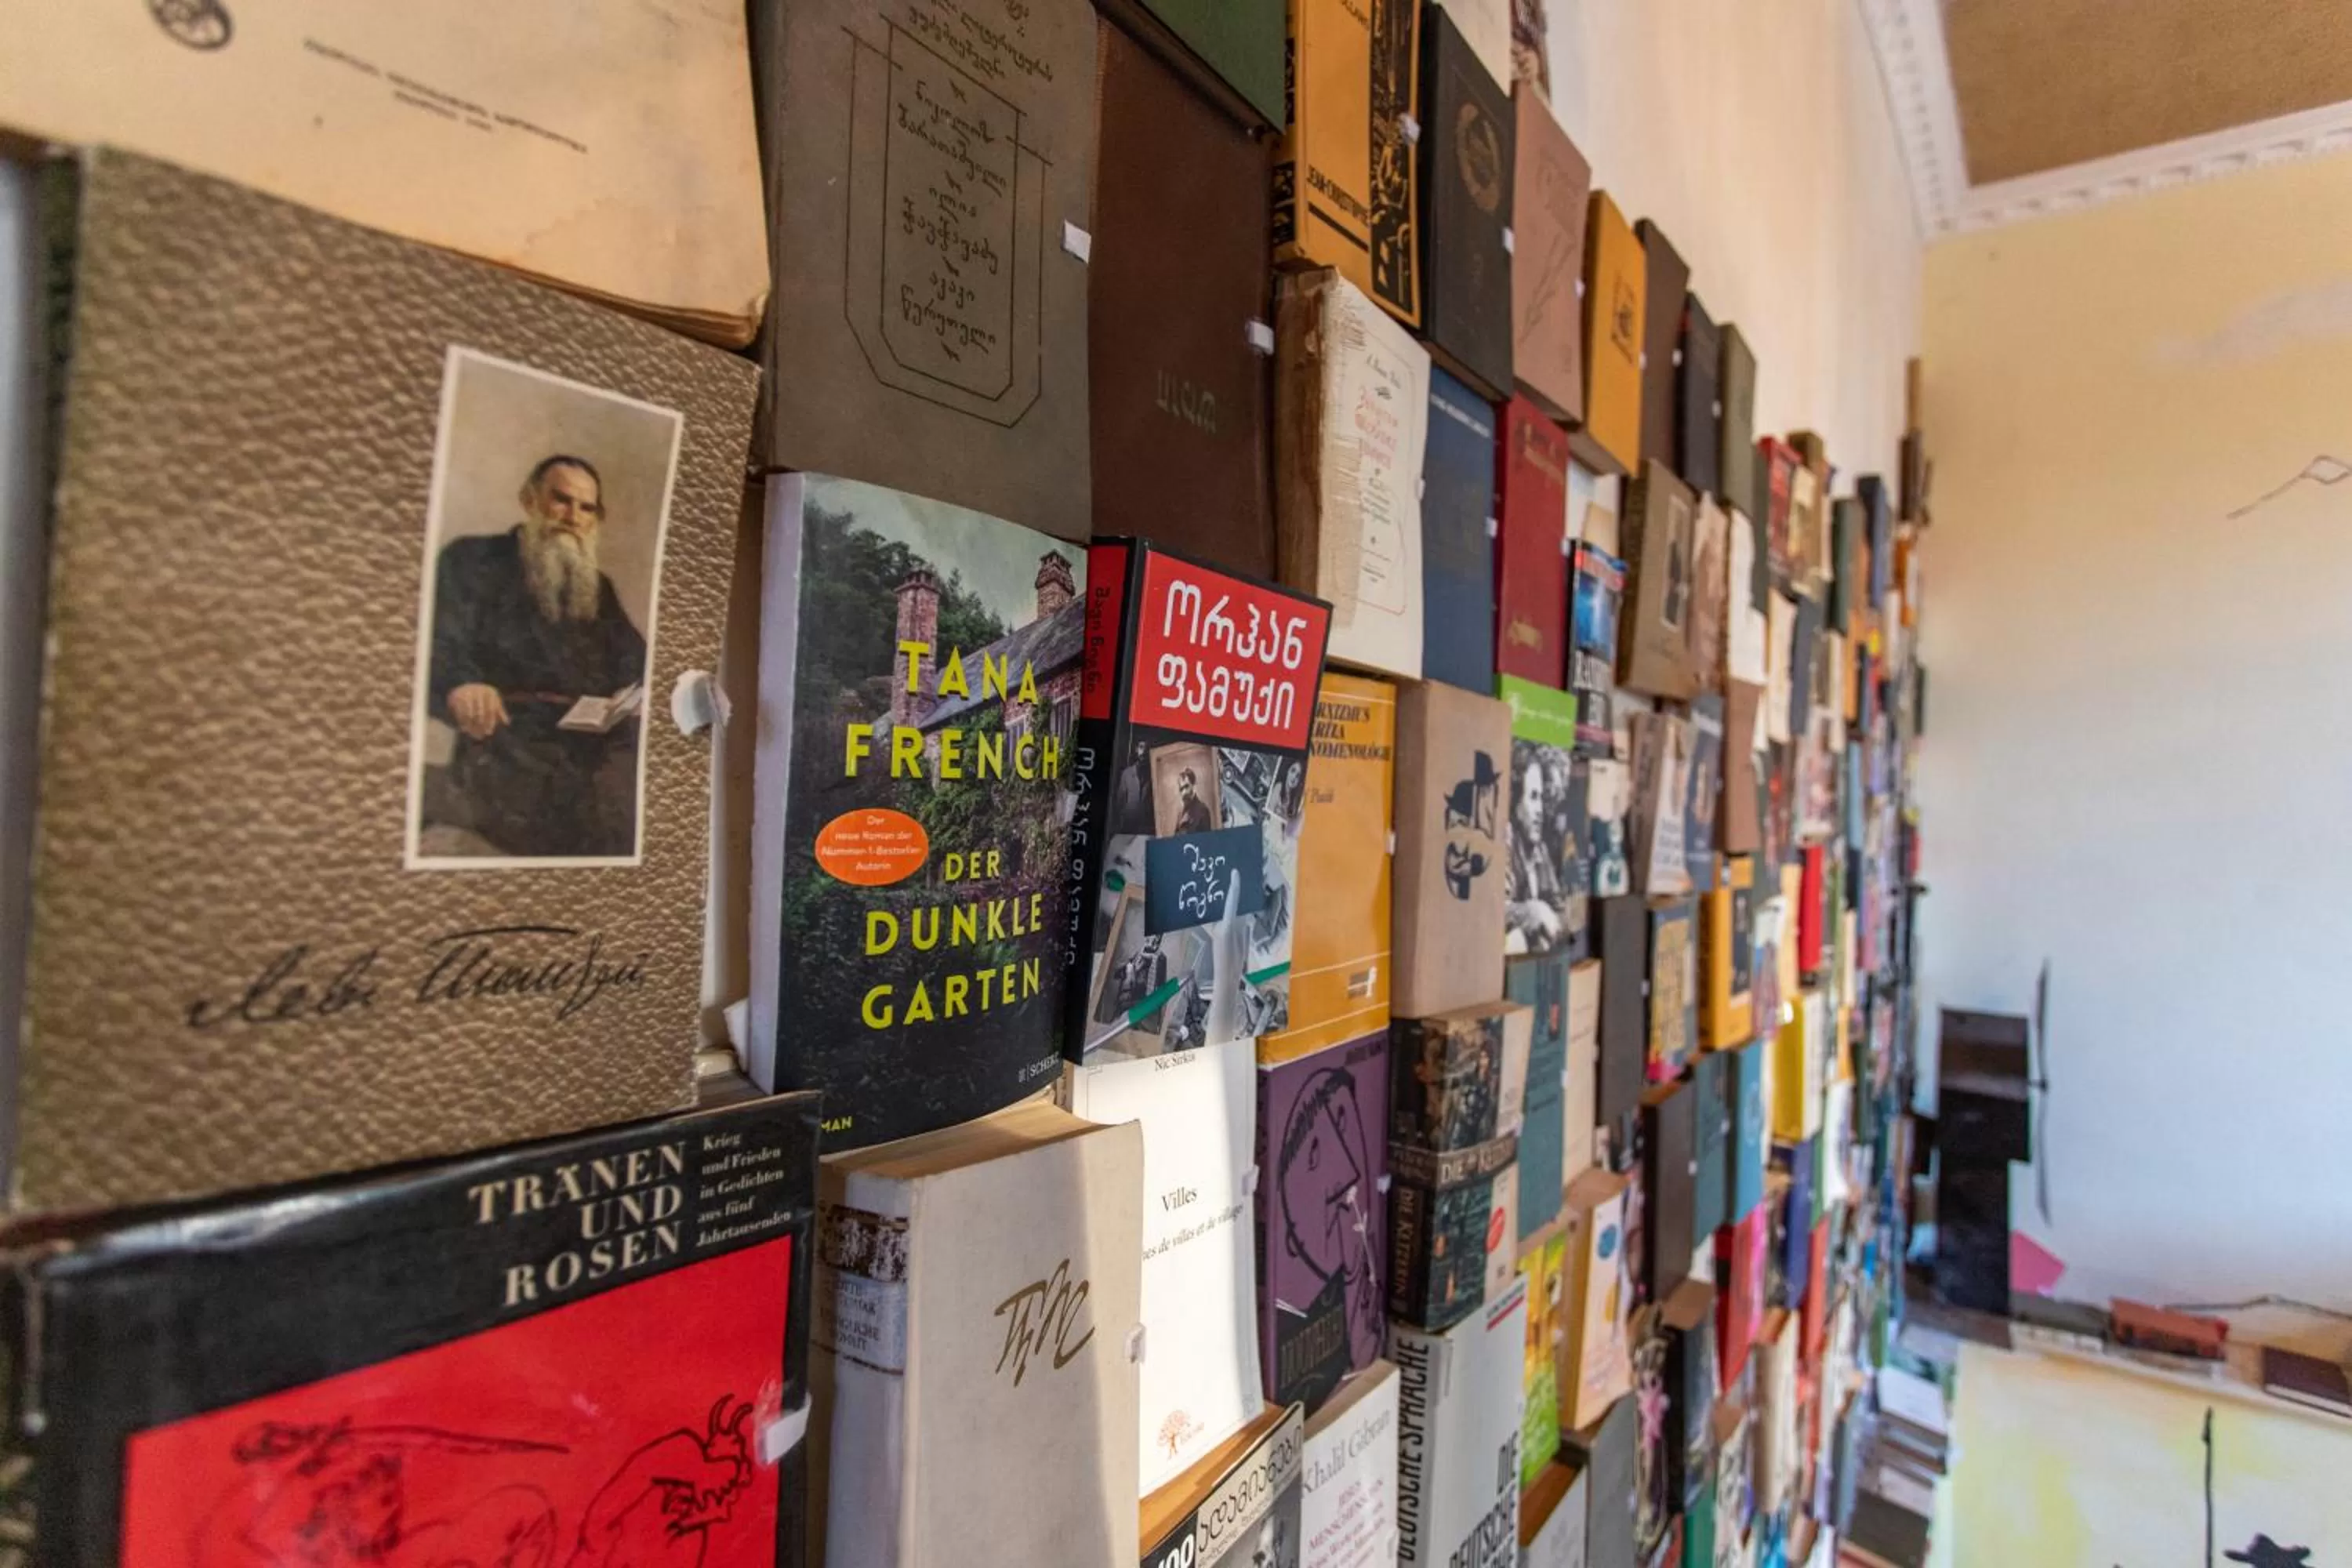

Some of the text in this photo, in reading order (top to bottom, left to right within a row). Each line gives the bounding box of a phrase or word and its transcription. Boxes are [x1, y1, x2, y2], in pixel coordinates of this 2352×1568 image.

[930, 187, 977, 223] ილია
[930, 270, 975, 309] აკაკი
[1163, 579, 1308, 670] ორჰან
[898, 640, 1040, 705] TANA
[1158, 653, 1296, 731] ფამუქი
[844, 722, 1060, 782] FRENCH
[866, 815, 885, 826] Der
[945, 850, 1001, 882] DER
[866, 893, 1043, 956] DUNKLE
[862, 957, 1040, 1029] GARTEN
[702, 1146, 781, 1174] und Frieden
[703, 1133, 741, 1150] Krieg
[468, 1142, 686, 1225] TRÄNEN
[699, 1168, 784, 1199] in Gedichten
[1162, 1186, 1198, 1211] Villes
[580, 1184, 683, 1240] UND
[695, 1211, 791, 1247] Jahrtausenden
[698, 1197, 754, 1223] aus fünf
[503, 1221, 681, 1307] ROSEN
[1301, 1439, 1345, 1494] Khalil
